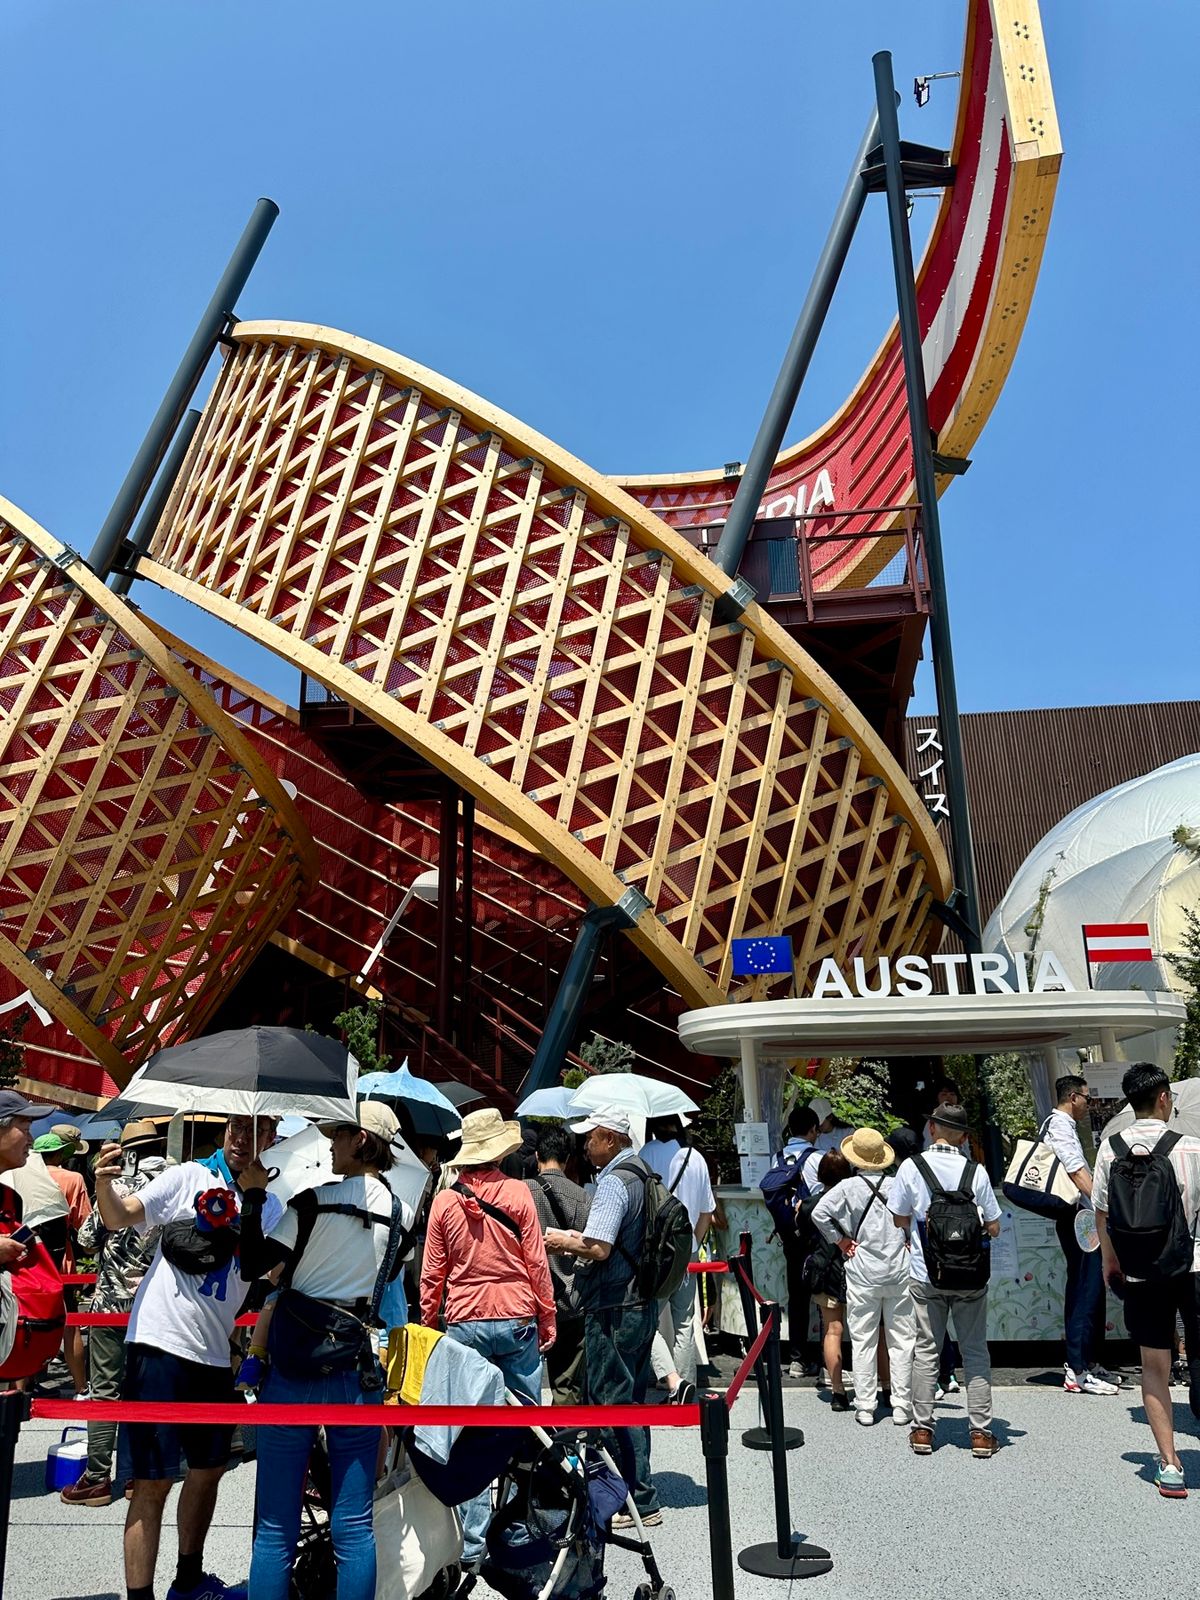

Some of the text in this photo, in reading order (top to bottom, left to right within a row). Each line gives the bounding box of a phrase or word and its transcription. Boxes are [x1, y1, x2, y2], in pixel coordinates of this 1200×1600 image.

[916, 728, 950, 816] スイス
[812, 951, 1076, 998] AUSTRIA
